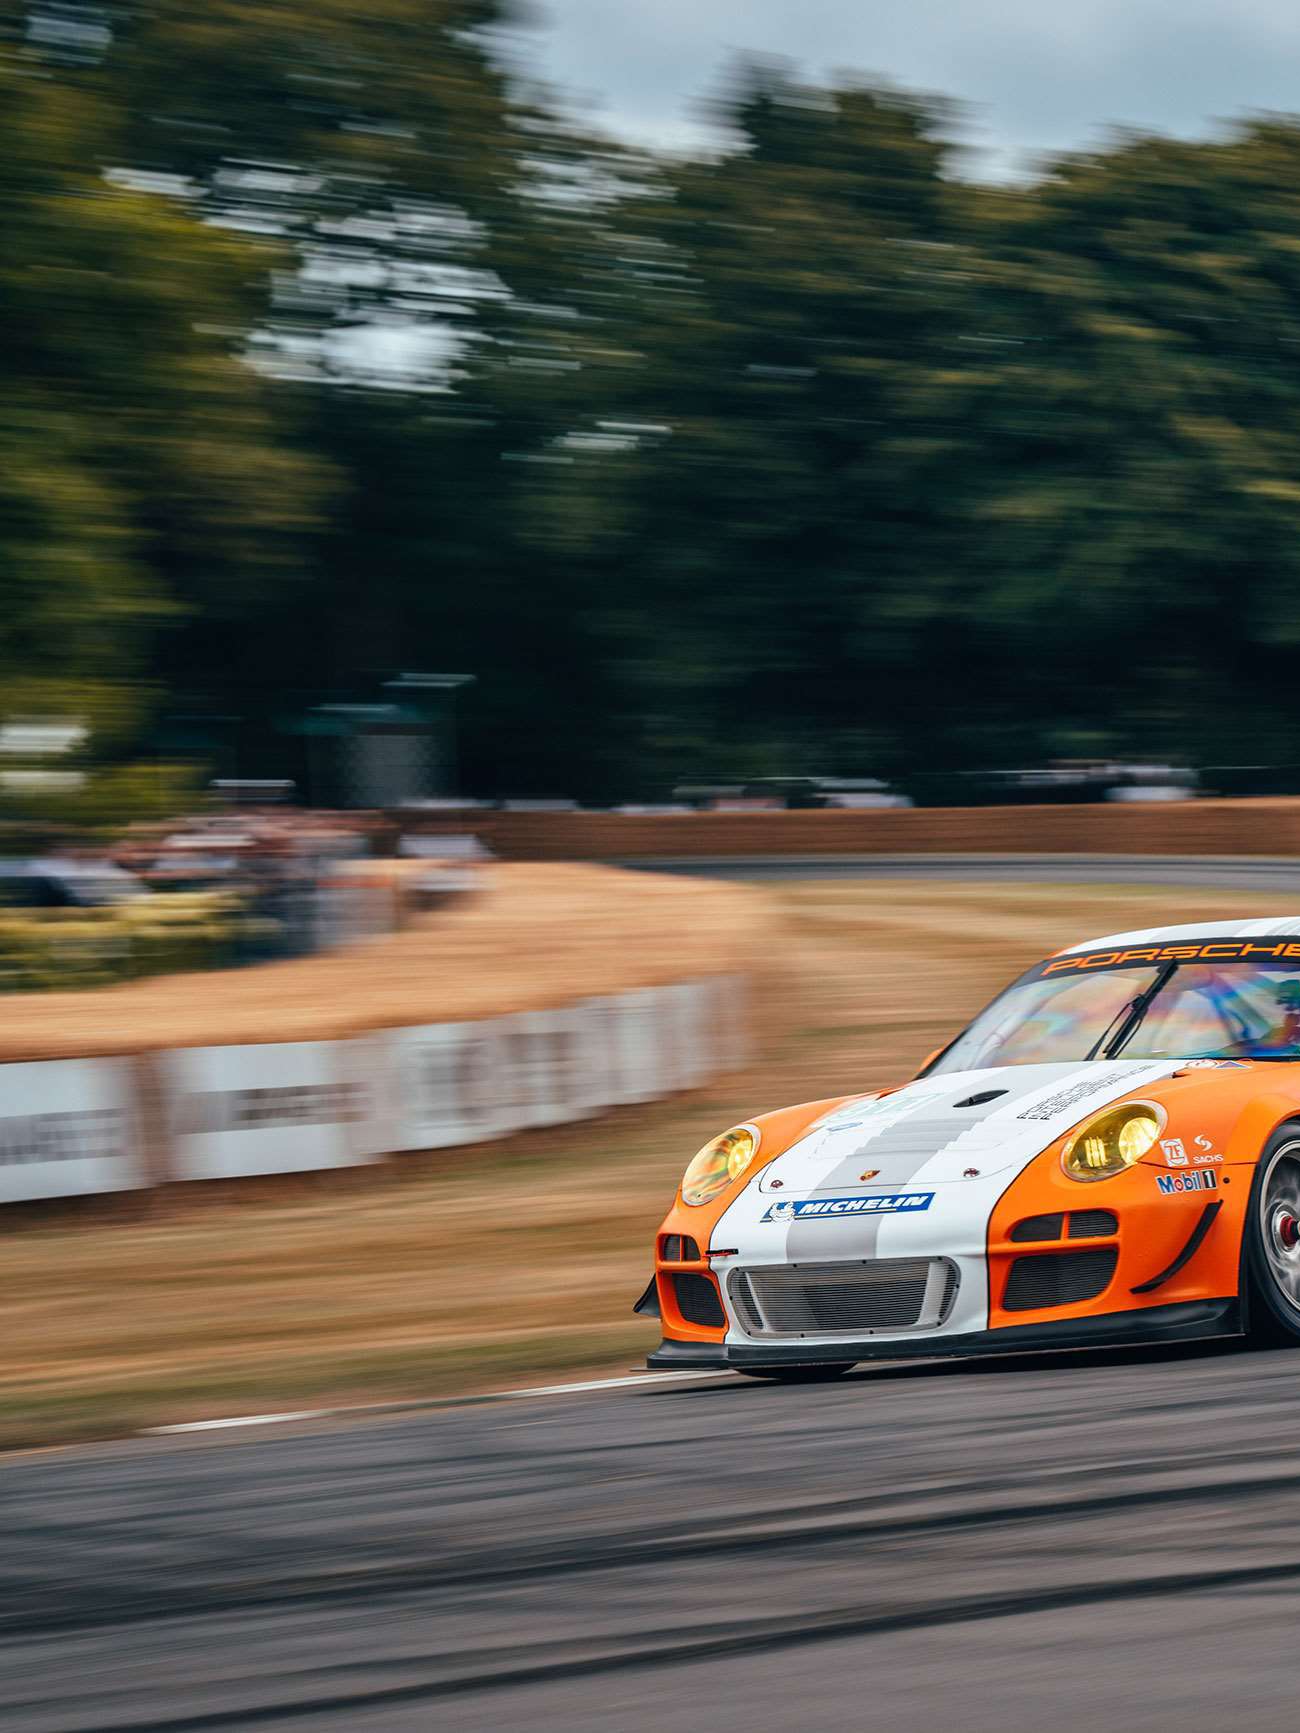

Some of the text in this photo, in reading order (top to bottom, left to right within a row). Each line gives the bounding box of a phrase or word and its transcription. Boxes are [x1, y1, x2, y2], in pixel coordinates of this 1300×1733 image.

[1192, 1153, 1224, 1164] SACHS
[1155, 1170, 1216, 1195] Mobil 1
[800, 1195, 929, 1215] MICHELIN
